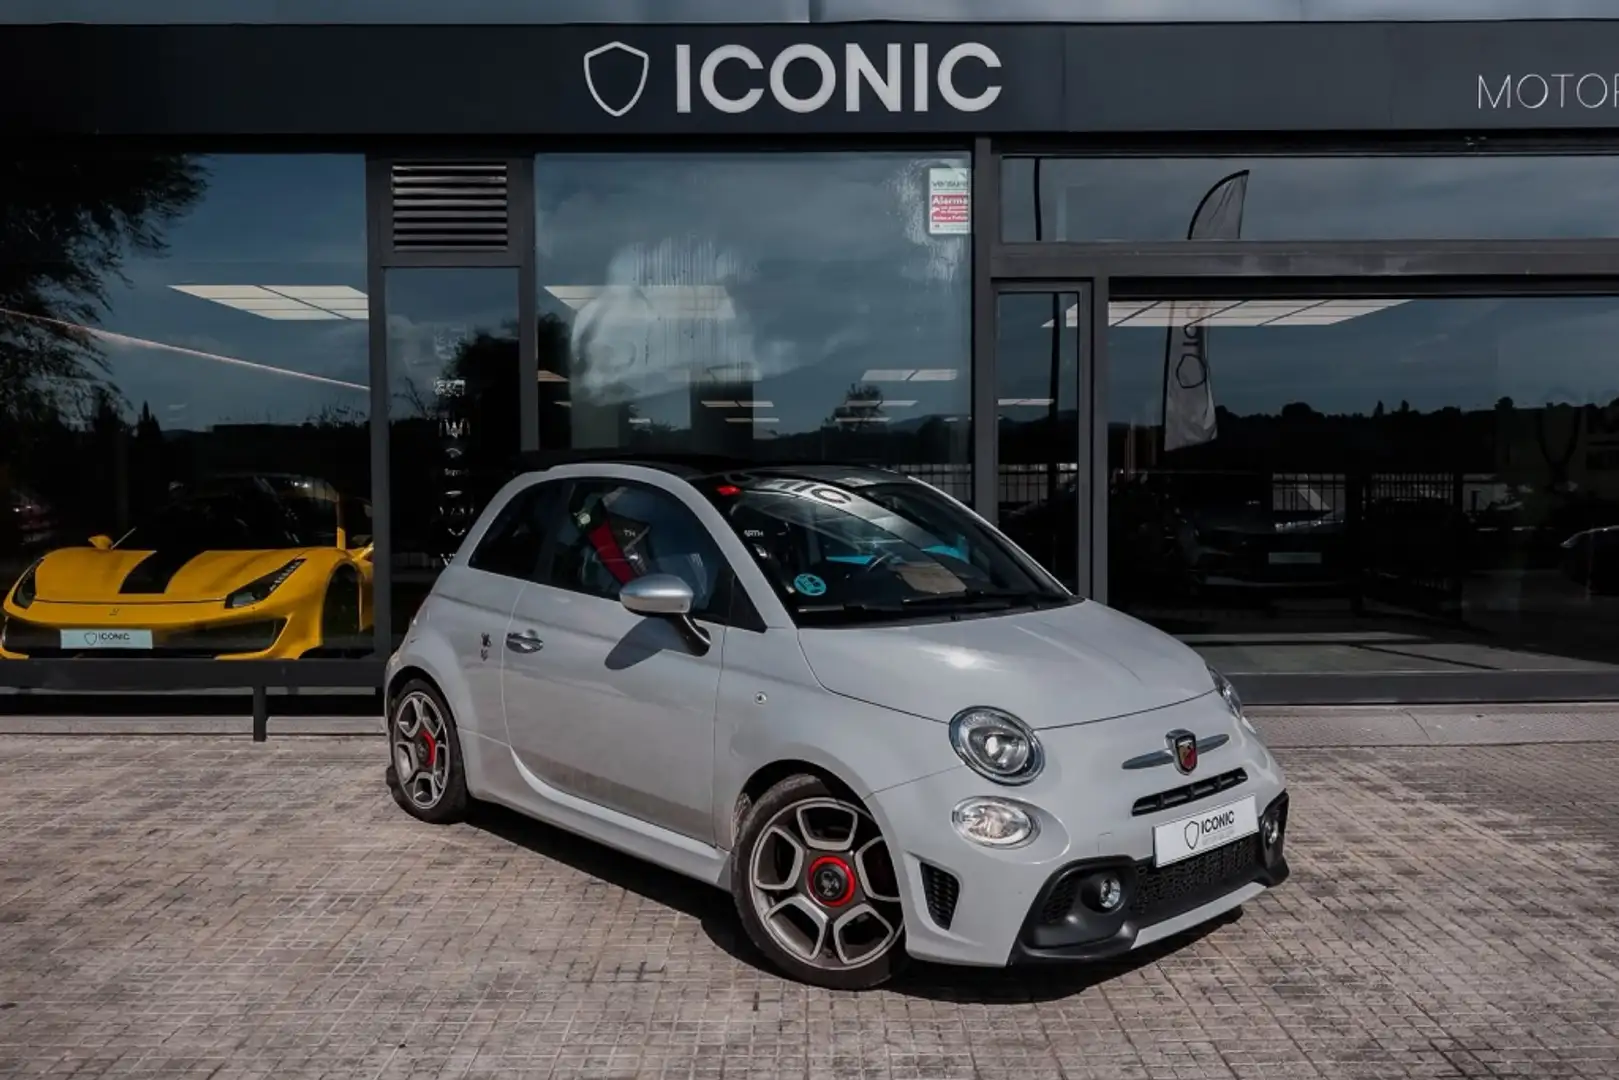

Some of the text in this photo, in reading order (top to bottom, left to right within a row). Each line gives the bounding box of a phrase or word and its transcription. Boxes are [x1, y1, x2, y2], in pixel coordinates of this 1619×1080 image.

[676, 42, 1003, 113] ICONIC
[1477, 73, 1619, 109] MOTO
[98, 632, 130, 640] ICONIC
[1201, 810, 1235, 834] ICONIC
